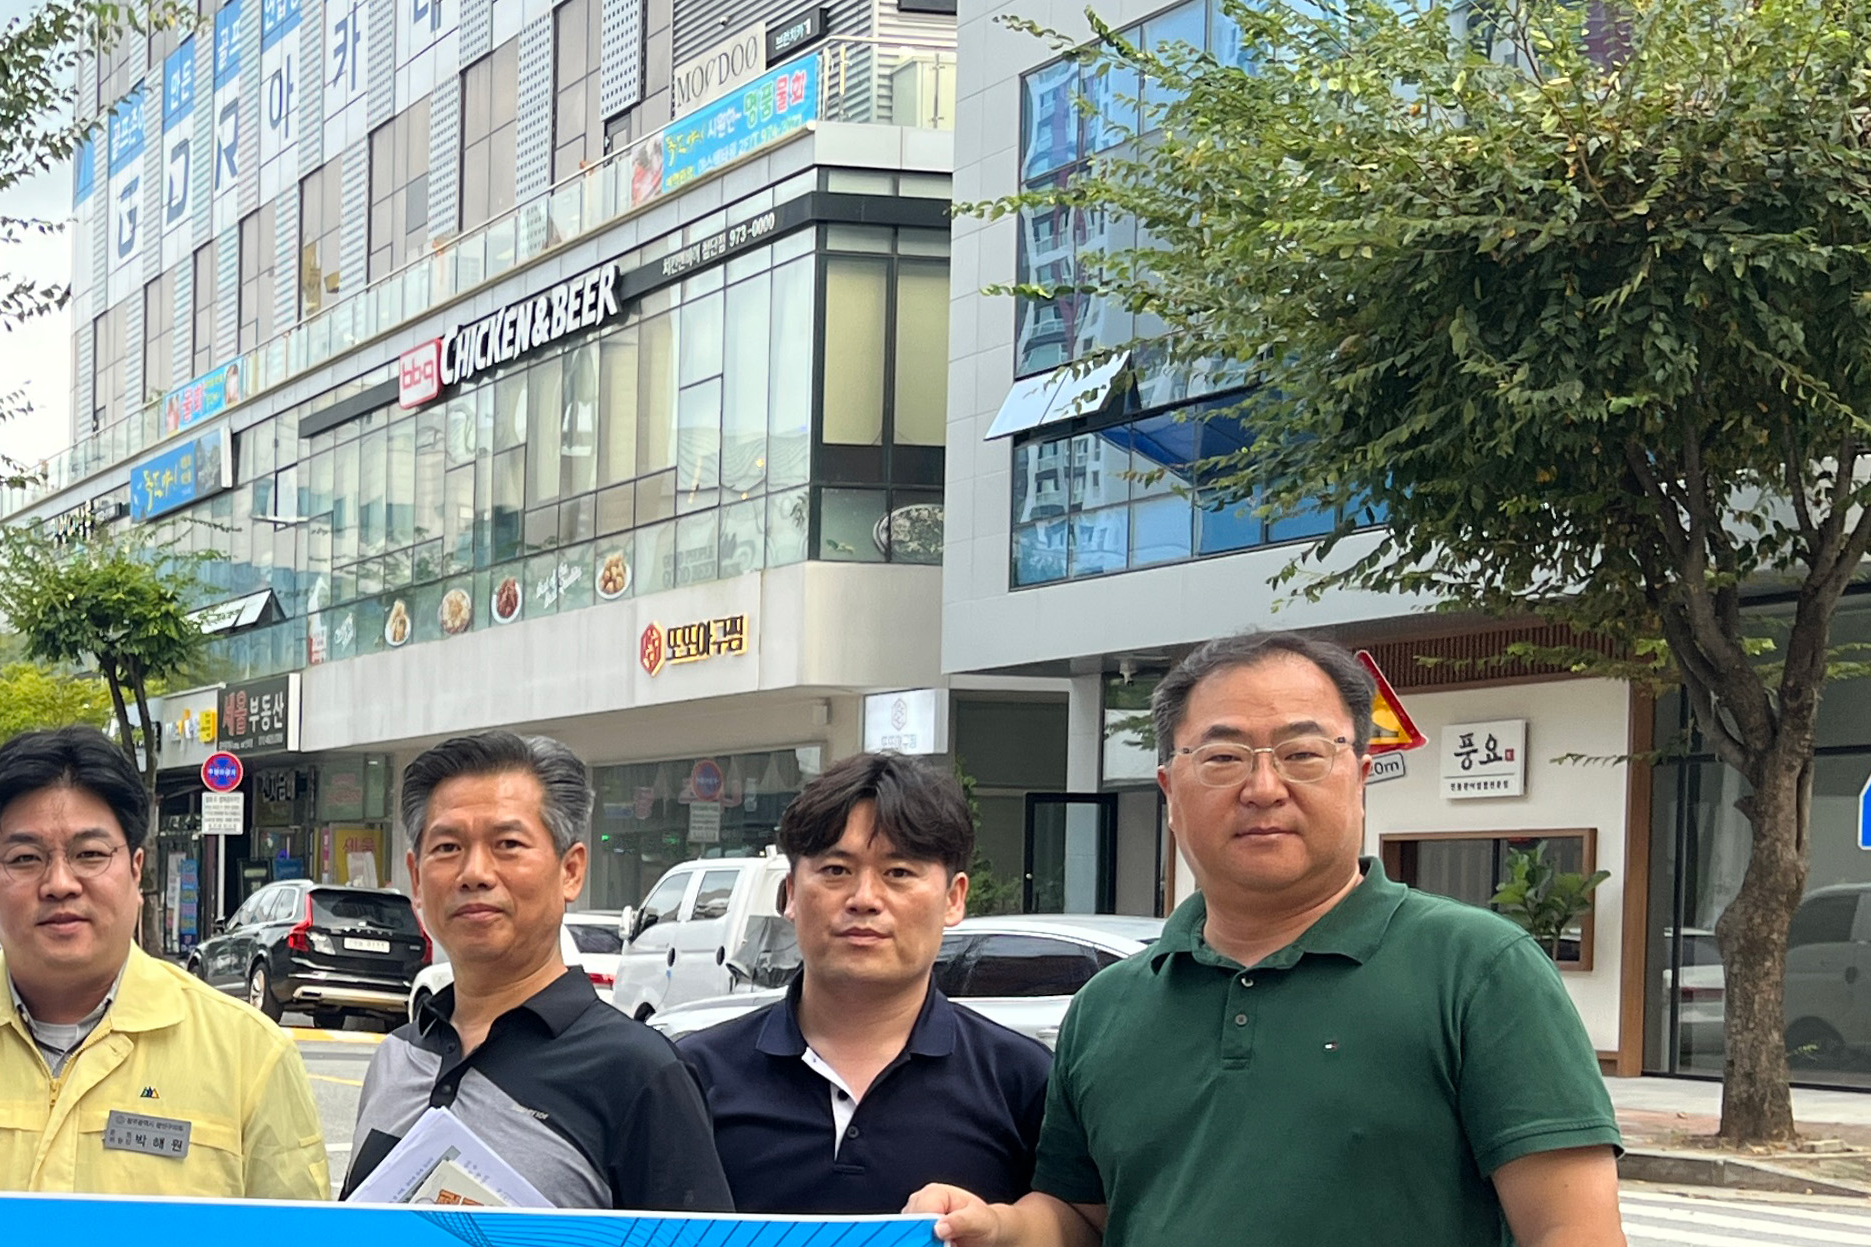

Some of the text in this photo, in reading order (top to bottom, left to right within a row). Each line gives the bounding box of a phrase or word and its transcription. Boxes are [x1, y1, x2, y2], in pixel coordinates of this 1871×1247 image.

[169, 59, 192, 111] 만든
[702, 232, 726, 260] 첨단점
[729, 212, 775, 248] 973-0000
[440, 264, 620, 385] CHICKEN&BEER
[665, 615, 745, 661] 또또아구찜
[1454, 733, 1503, 771] 풍요
[135, 1133, 183, 1152] 박해원
